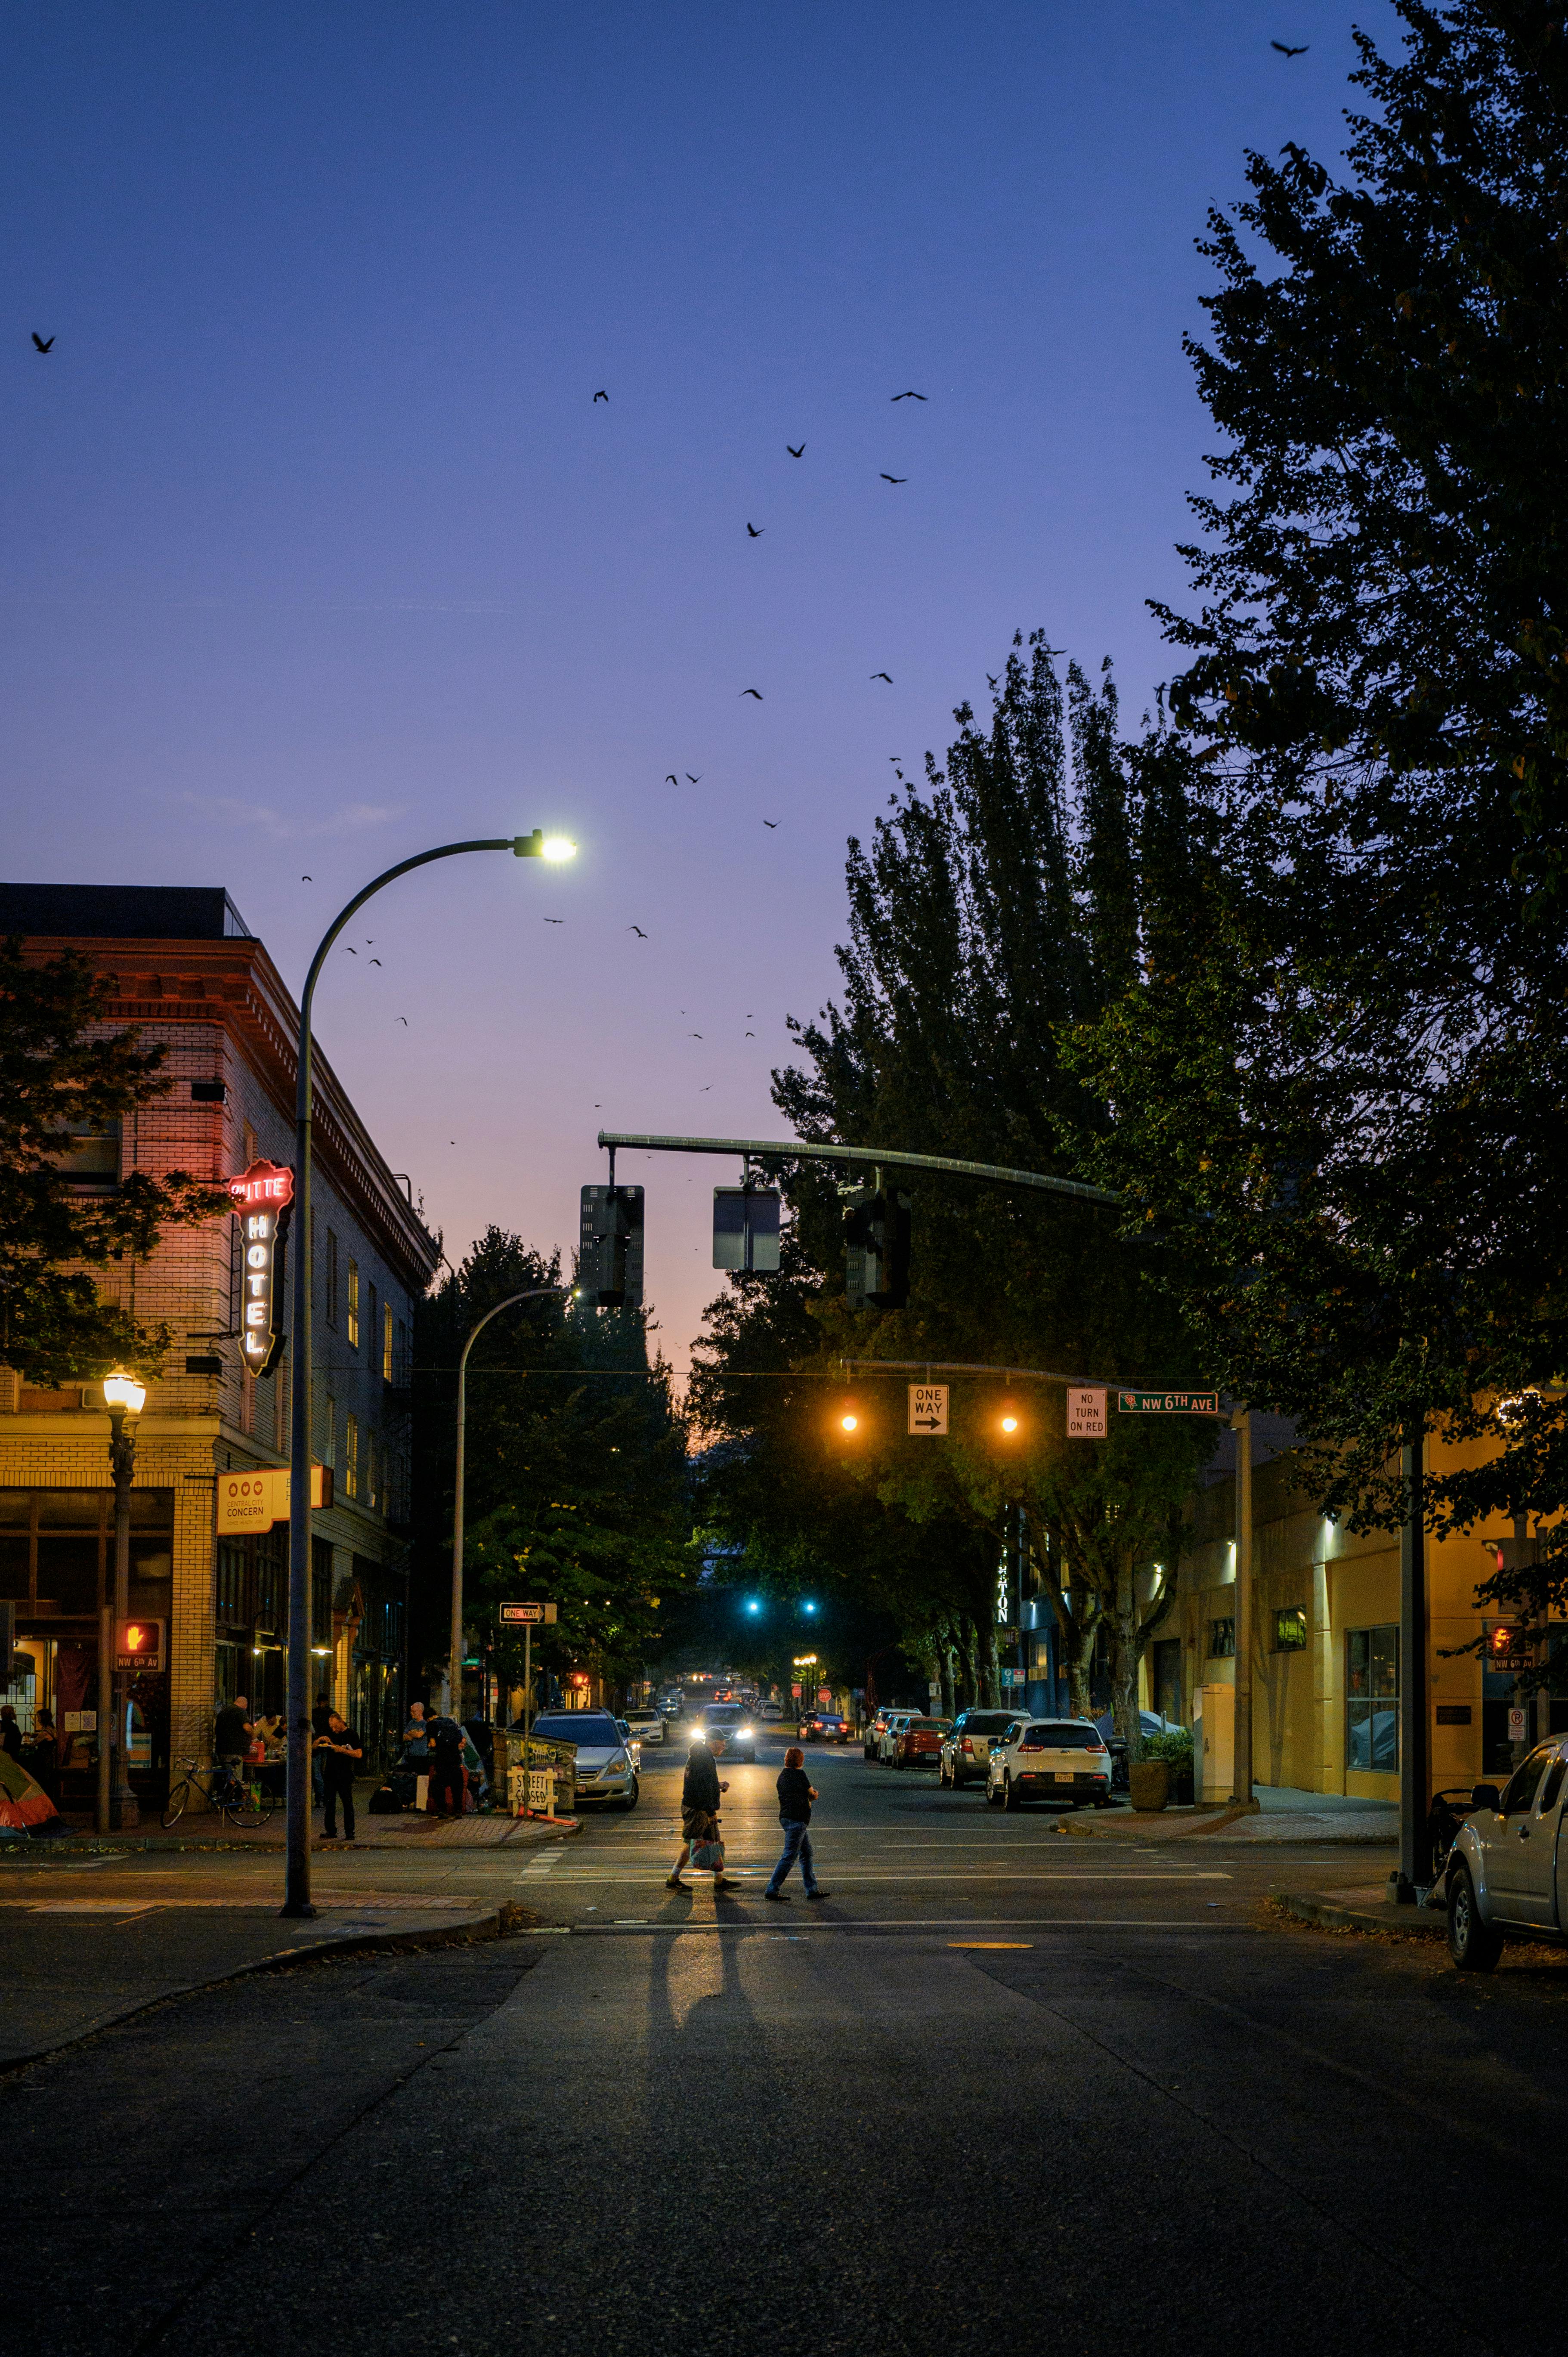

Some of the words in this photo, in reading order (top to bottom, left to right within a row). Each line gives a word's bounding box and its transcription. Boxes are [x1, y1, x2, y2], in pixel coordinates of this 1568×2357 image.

[247, 1215, 268, 1353] HOTEL
[916, 1389, 942, 1400] ONE
[1081, 1394, 1093, 1404] NO
[1142, 1399, 1161, 1410] NW
[1165, 1395, 1188, 1410] 6TH
[1191, 1399, 1212, 1410] AVE
[915, 1402, 943, 1414] WAY
[1076, 1408, 1098, 1417] TURN
[1070, 1422, 1082, 1431] ON
[1086, 1422, 1104, 1431] RED
[227, 1507, 264, 1517] CONCERN
[118, 1658, 131, 1667] NW
[134, 1658, 145, 1667] 6th
[1496, 1660, 1507, 1668] NW
